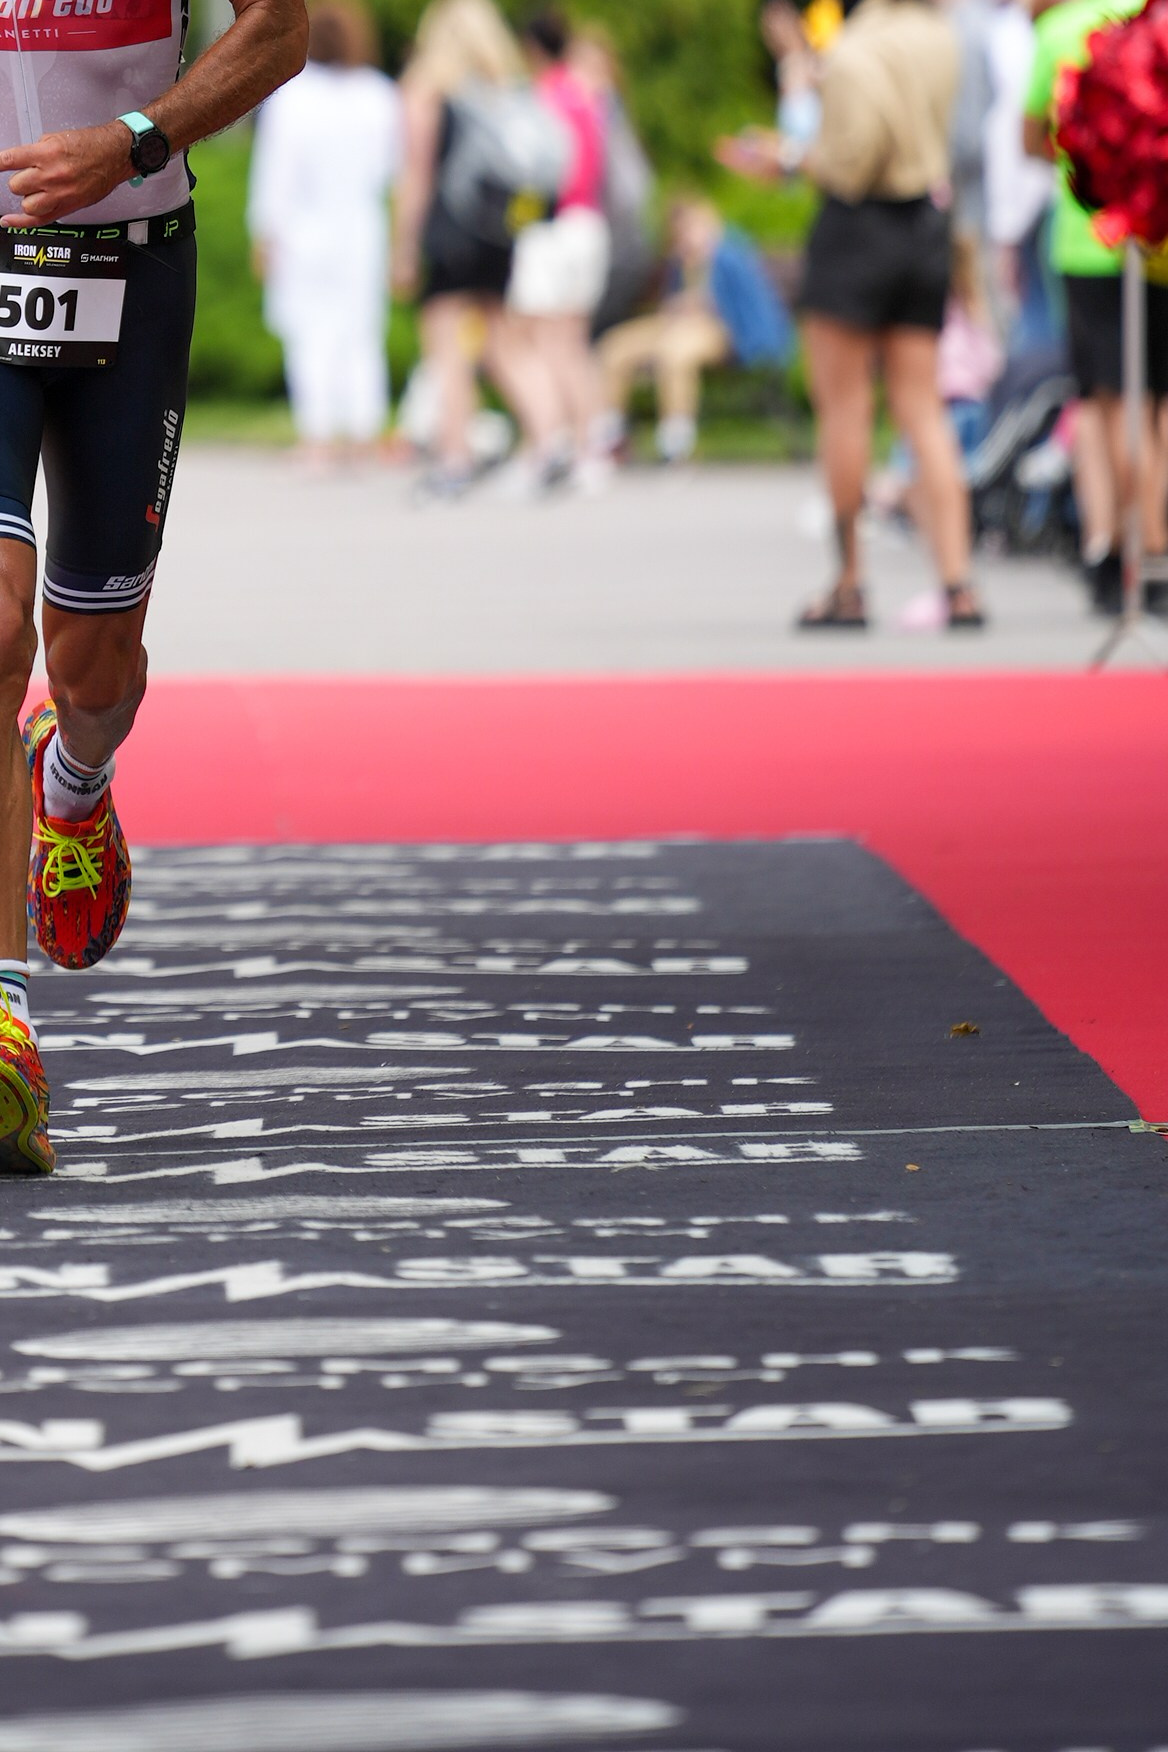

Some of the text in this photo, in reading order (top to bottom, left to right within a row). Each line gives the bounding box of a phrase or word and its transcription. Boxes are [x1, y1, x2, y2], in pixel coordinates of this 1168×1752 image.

[14, 244, 71, 259] IRON STAR
[90, 255, 119, 263] МАГНИТ
[8, 343, 62, 358] ALEKSEY
[145, 409, 178, 533] Segafredo
[50, 763, 108, 795] IRONMAN
[366, 1031, 796, 1047] STAR
[361, 1102, 834, 1125] STAR
[361, 1141, 863, 1166] STAR
[396, 1250, 959, 1280] STAR
[427, 1396, 1070, 1441] STAR
[458, 1582, 1168, 1637] STAR
